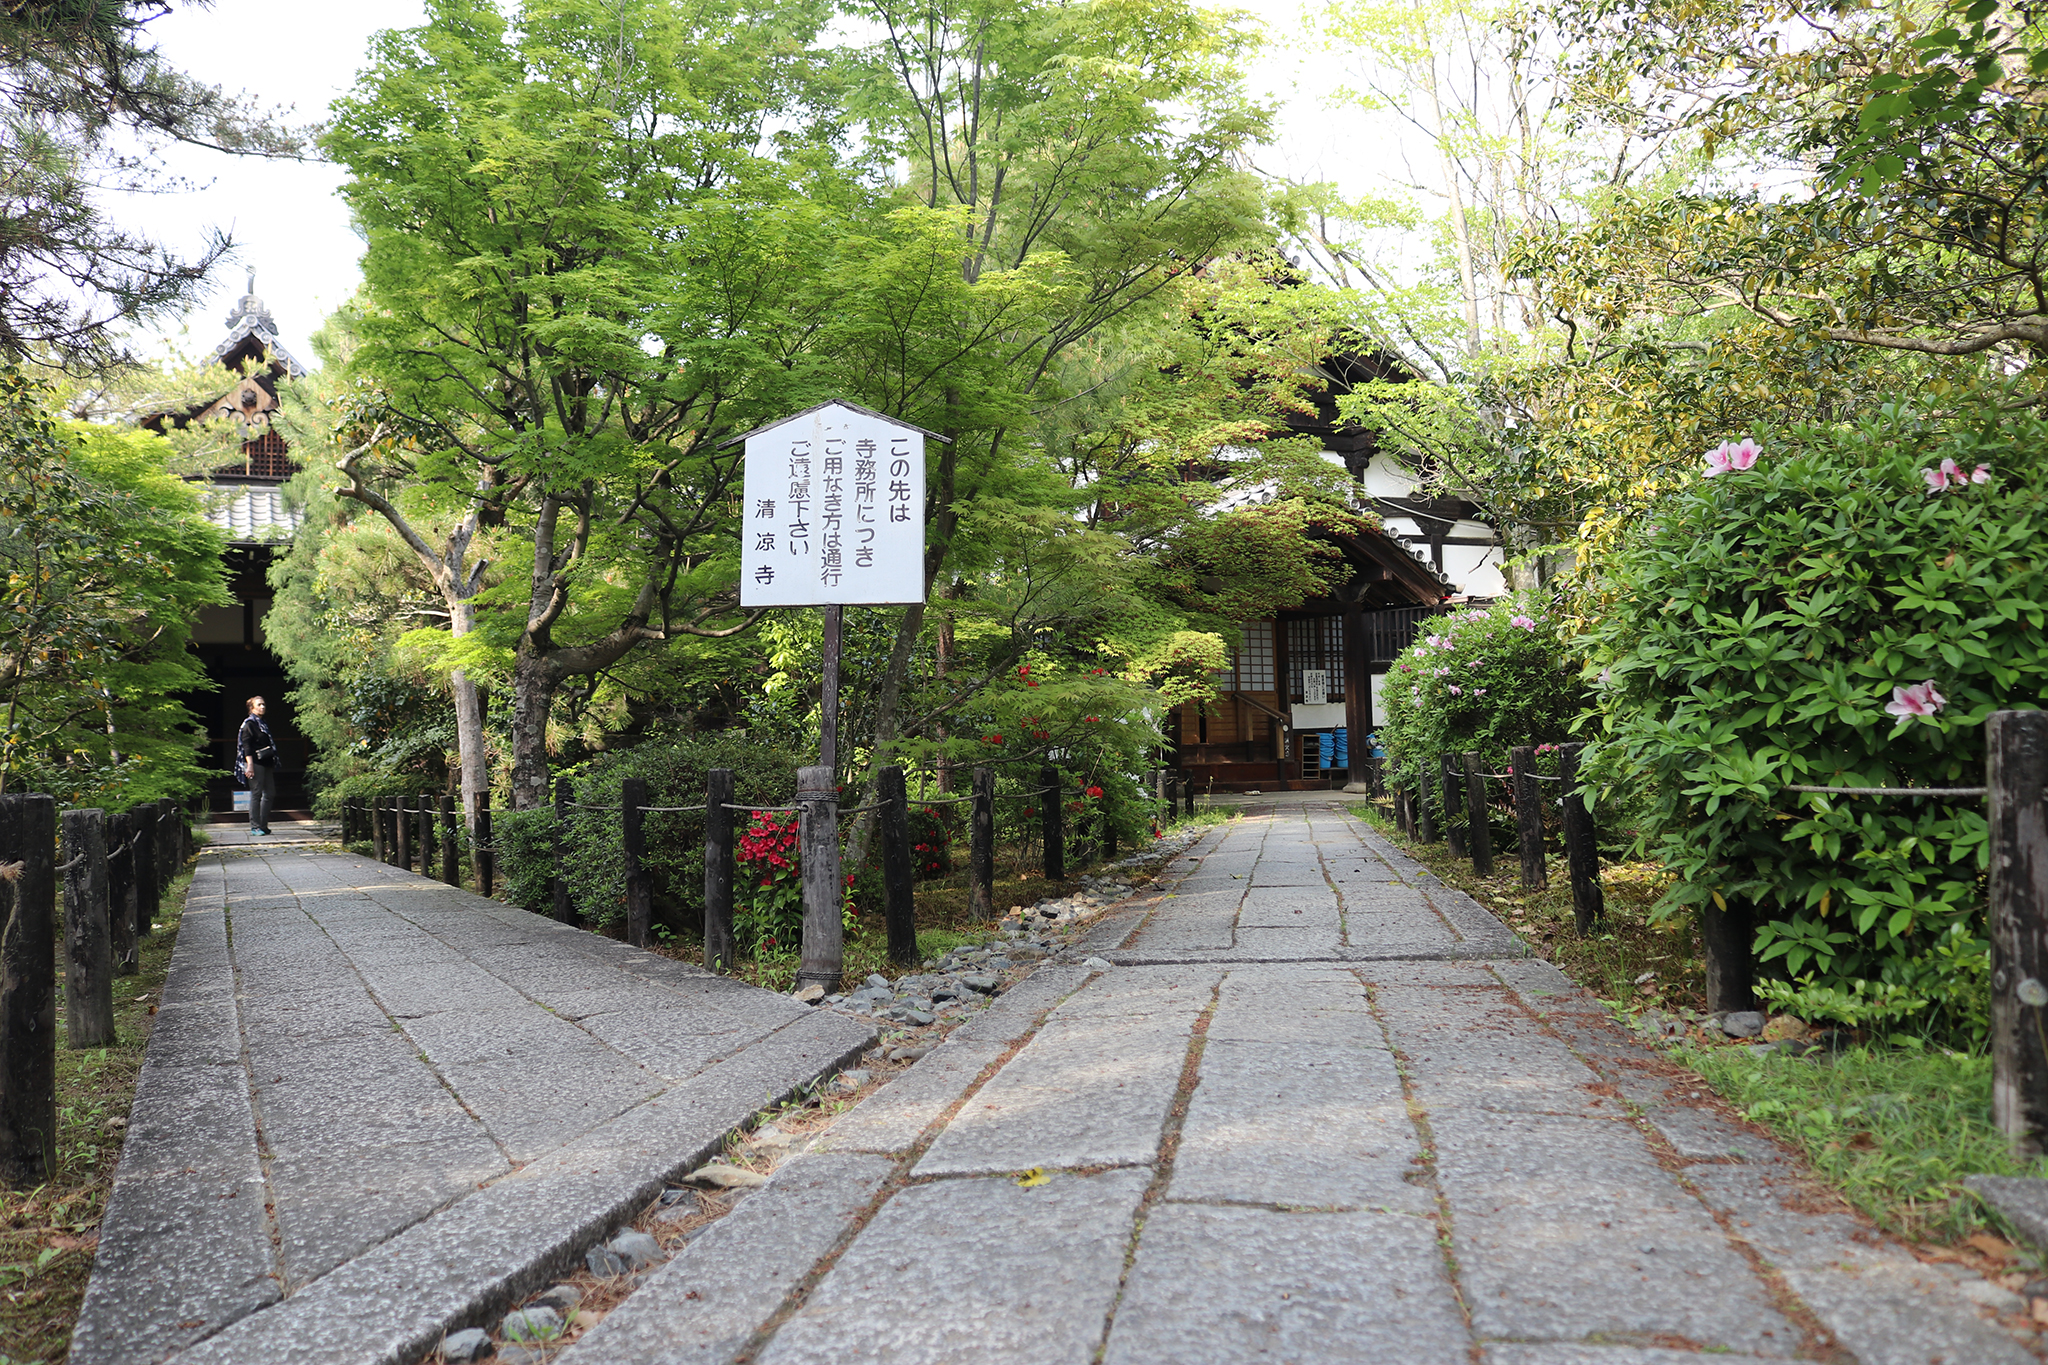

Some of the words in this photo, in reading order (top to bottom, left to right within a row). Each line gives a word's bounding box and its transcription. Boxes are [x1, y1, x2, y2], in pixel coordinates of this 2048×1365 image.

[788, 440, 812, 556] ご遠慮下さい
[820, 438, 847, 588] ご用なき方は通行
[855, 438, 878, 568] 寺務所につき
[888, 438, 911, 523] この先は
